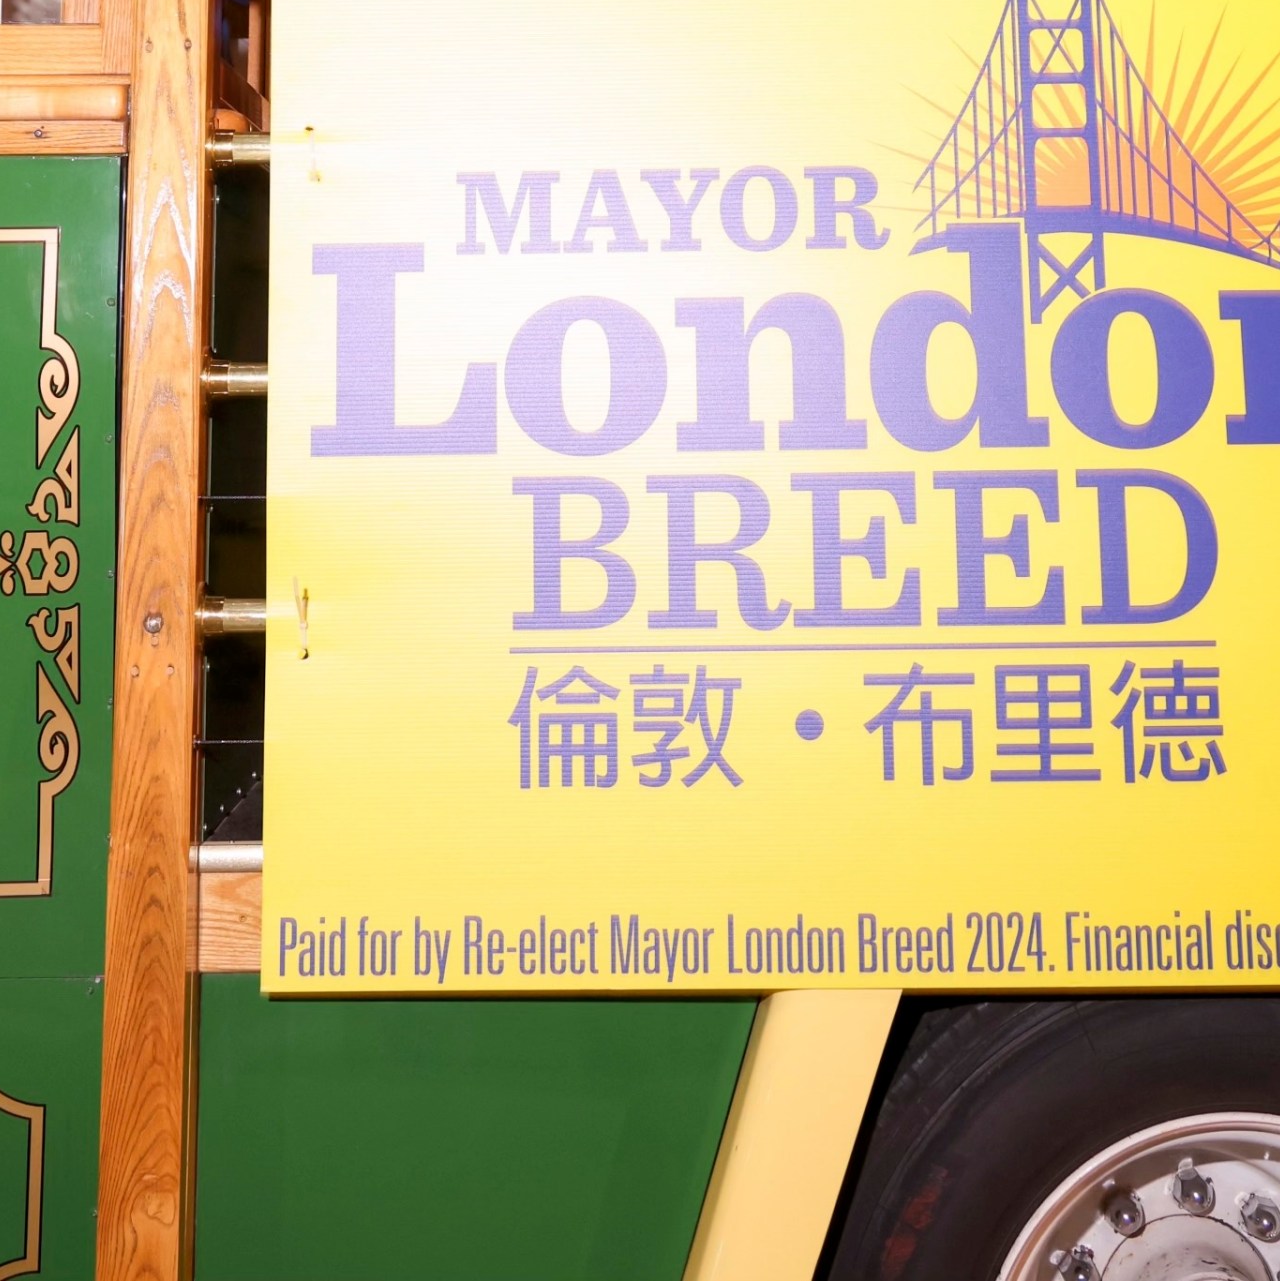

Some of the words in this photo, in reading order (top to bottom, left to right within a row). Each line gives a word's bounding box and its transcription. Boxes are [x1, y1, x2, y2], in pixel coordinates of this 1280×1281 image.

[455, 165, 890, 255] MAYOR
[511, 467, 1219, 632] BREED
[279, 916, 346, 977] Paid
[357, 916, 402, 977] for
[414, 917, 451, 984] by
[463, 914, 598, 977] Re-elect
[609, 914, 715, 983] Mayor
[727, 911, 841, 975] London
[857, 910, 954, 974] Breed
[966, 910, 1056, 974] 2024.
[1066, 909, 1213, 972] Financial
